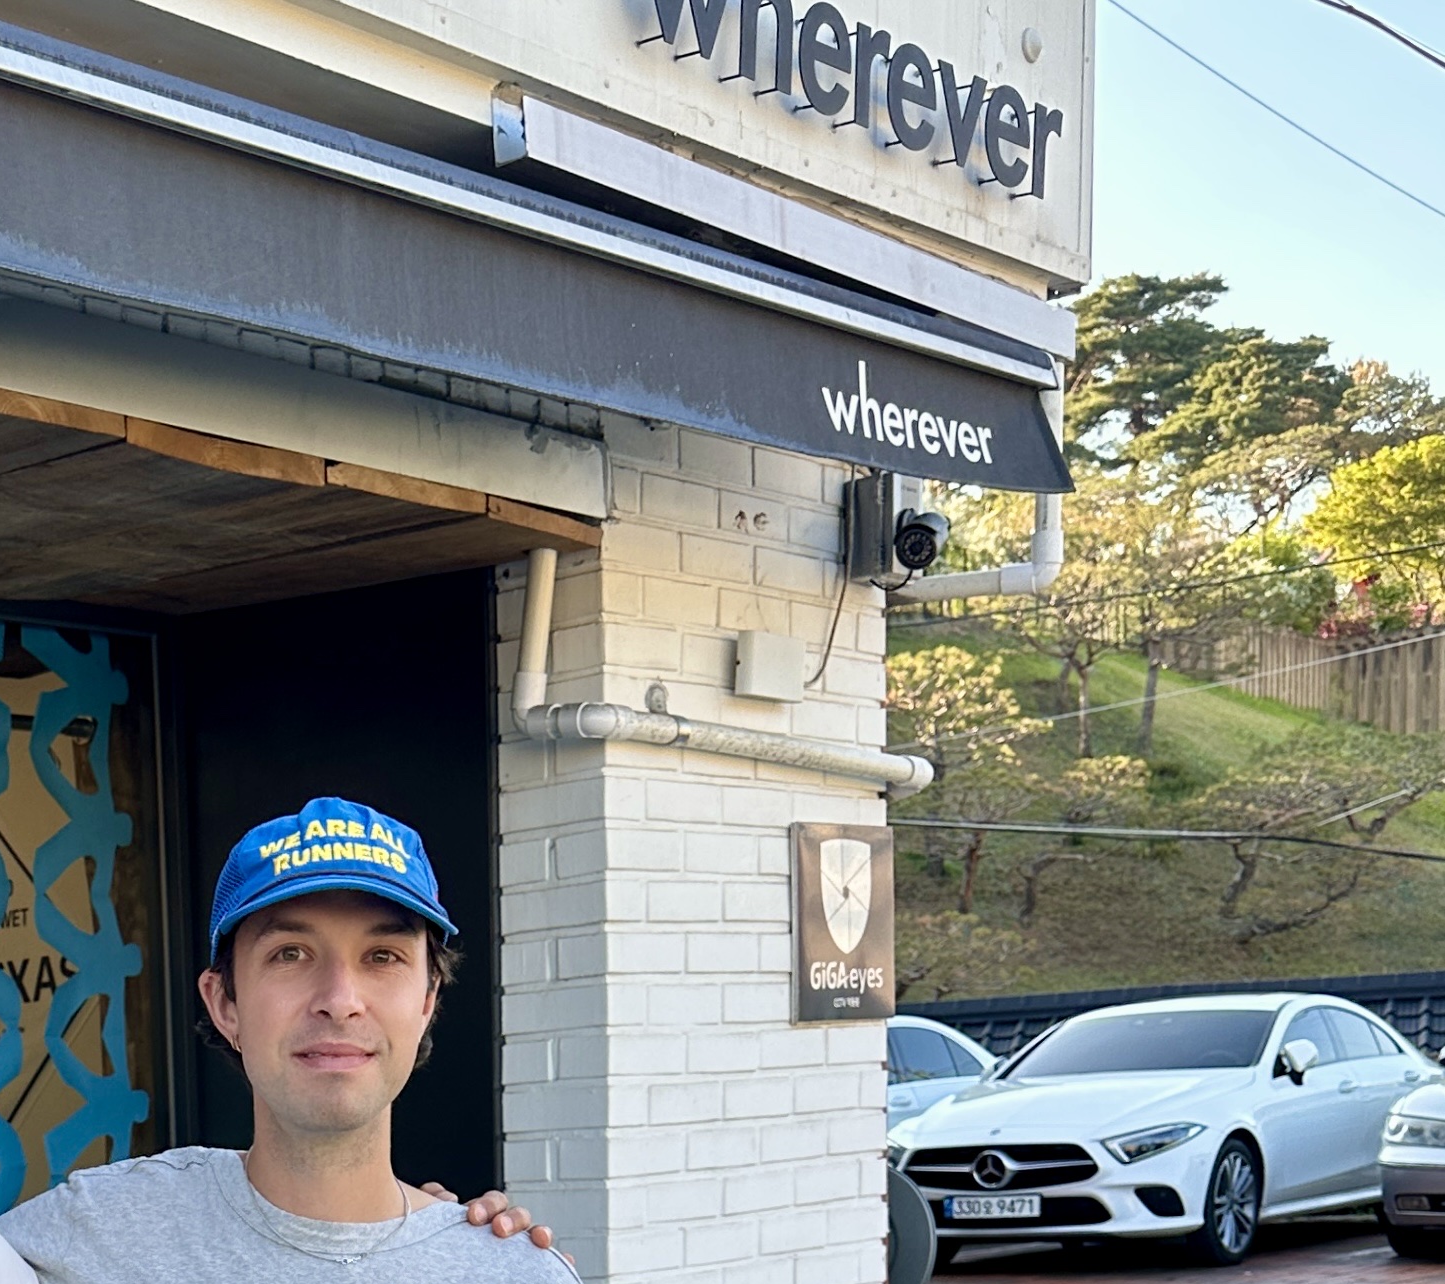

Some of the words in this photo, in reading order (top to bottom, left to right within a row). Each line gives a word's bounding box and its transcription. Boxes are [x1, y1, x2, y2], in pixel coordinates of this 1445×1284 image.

[822, 360, 993, 464] wherever
[259, 831, 301, 859] WE
[304, 819, 366, 841] ARE
[370, 823, 411, 859] ALL
[273, 842, 407, 876] RUNNERS
